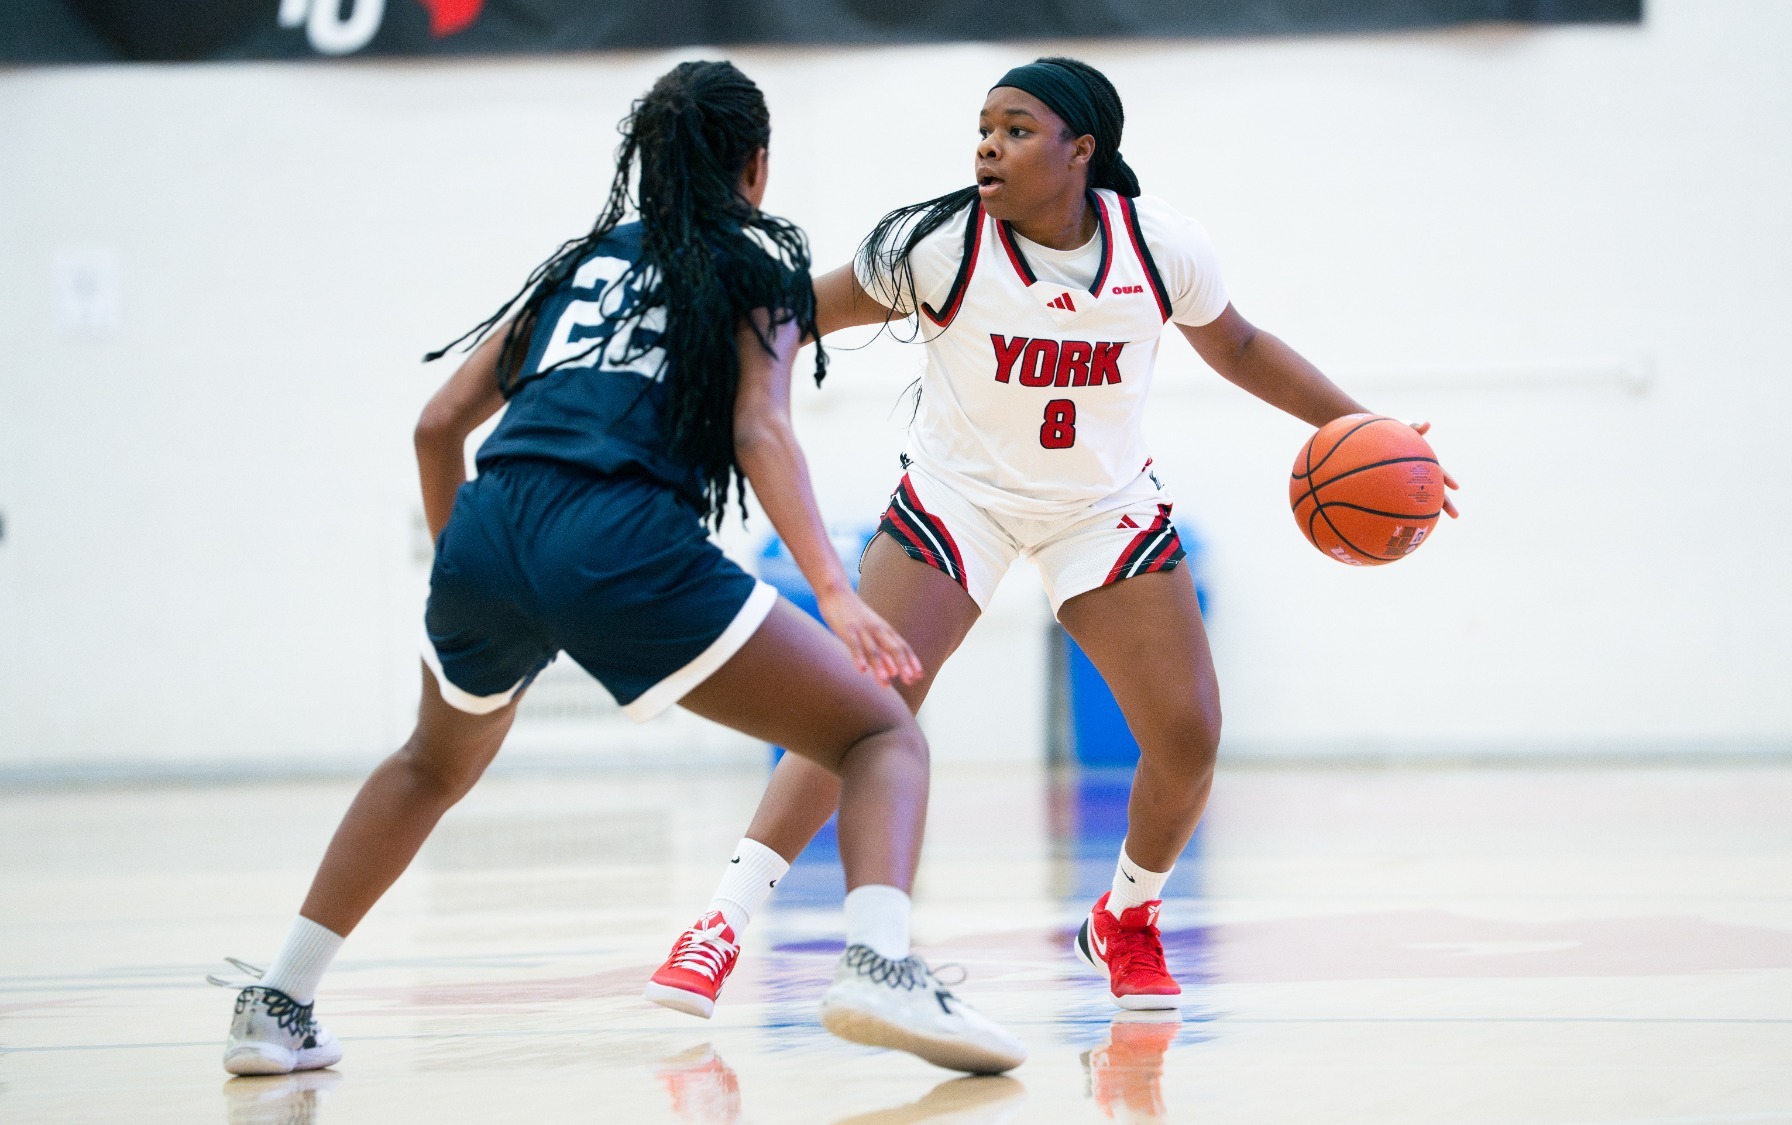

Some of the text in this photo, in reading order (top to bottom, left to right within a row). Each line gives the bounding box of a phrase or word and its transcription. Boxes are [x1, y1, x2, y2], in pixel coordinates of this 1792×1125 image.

[1112, 285, 1144, 295] OUA
[536, 256, 669, 383] 22
[989, 333, 1130, 388] YORK
[1039, 398, 1076, 450] 8
